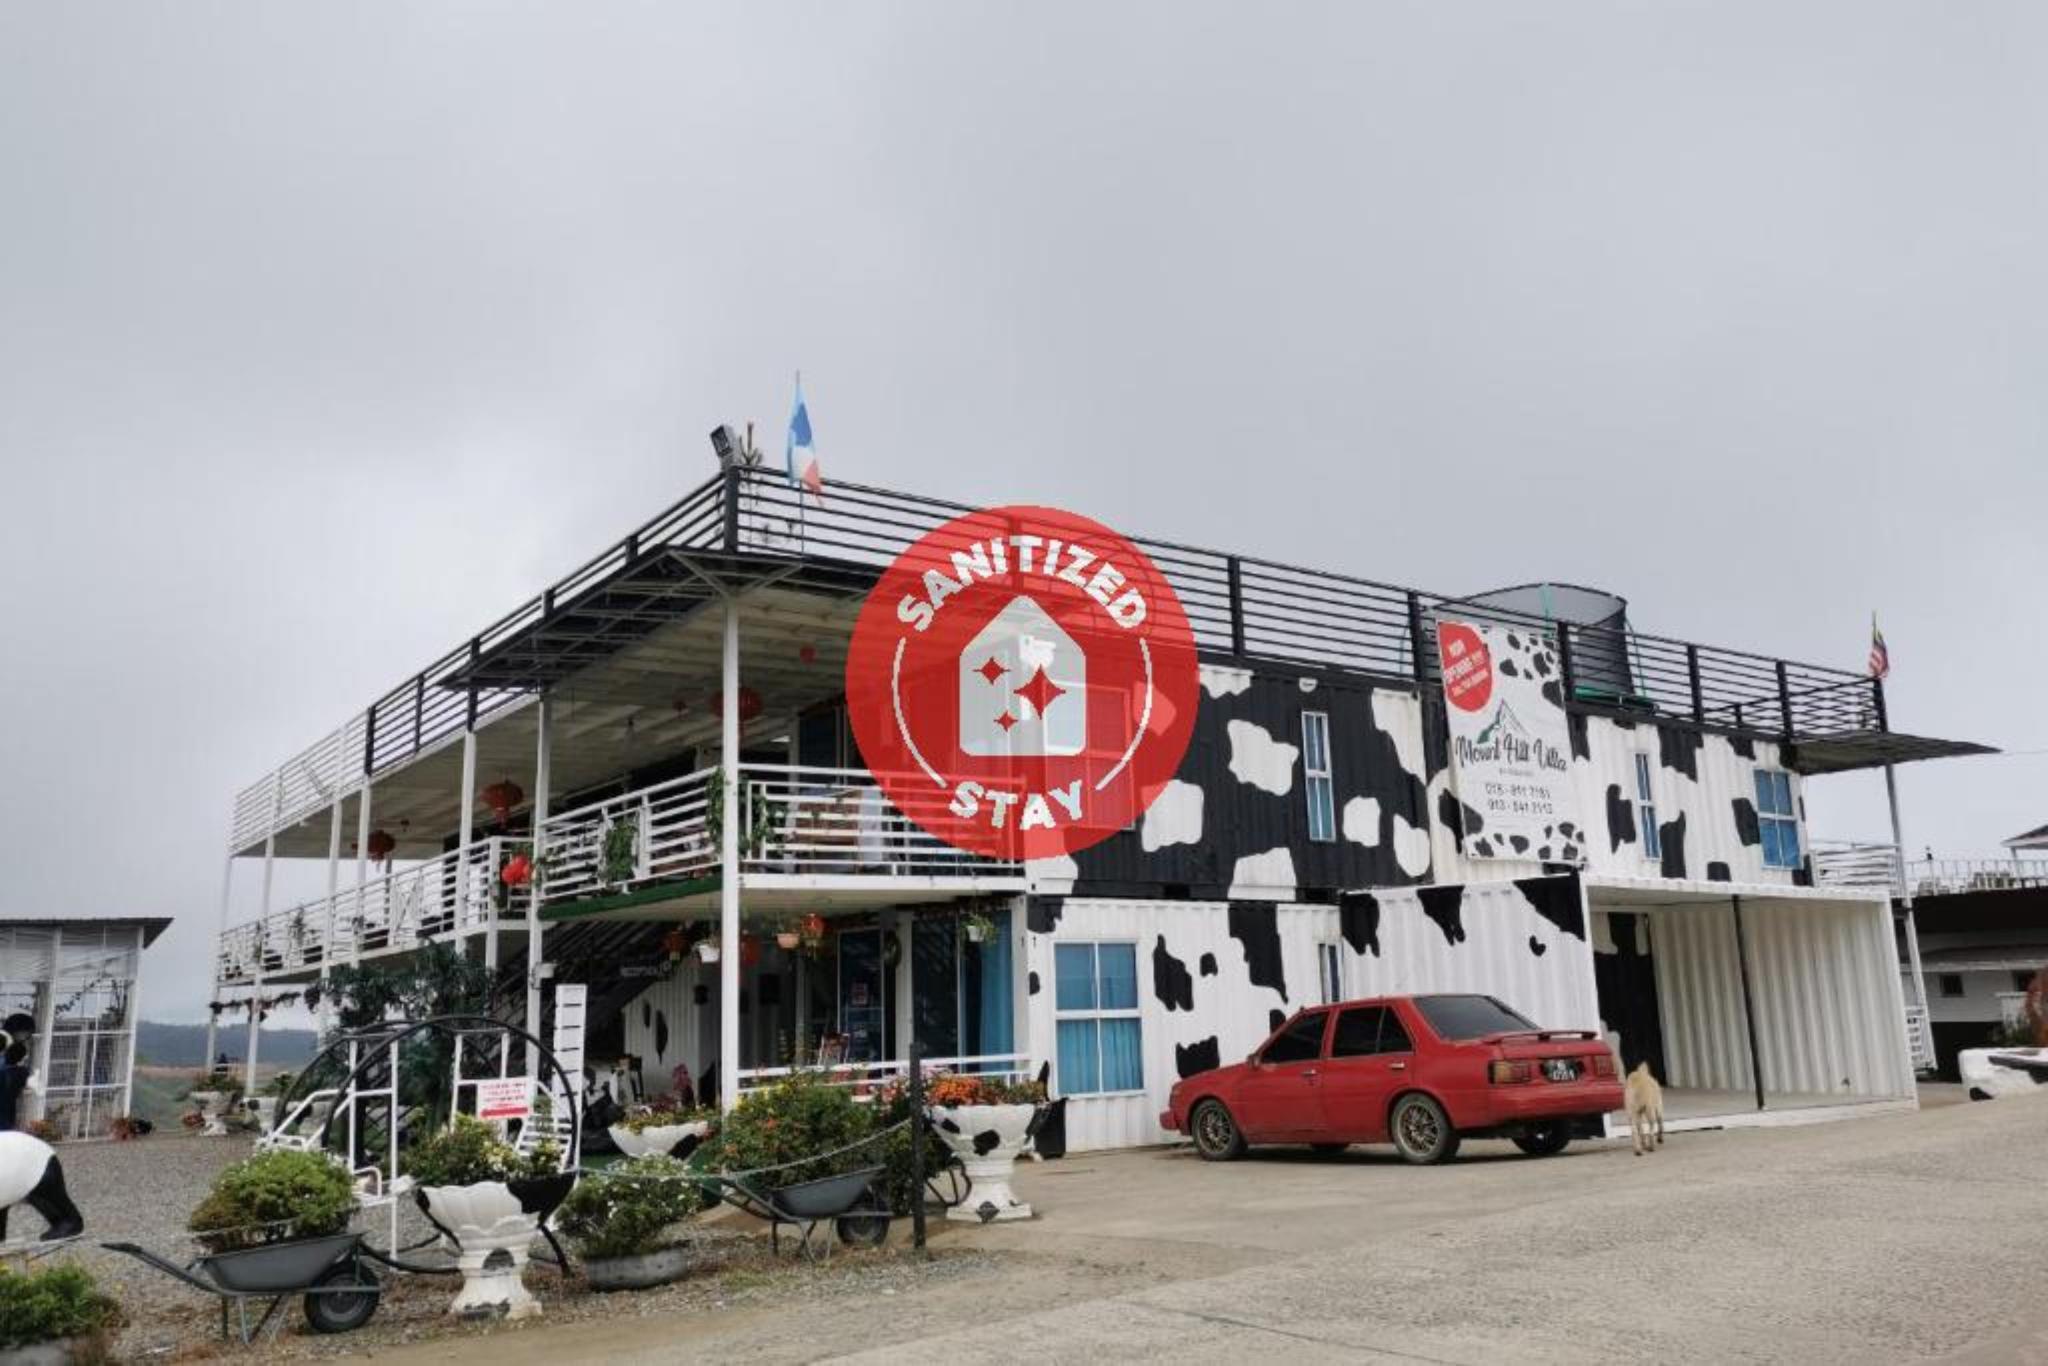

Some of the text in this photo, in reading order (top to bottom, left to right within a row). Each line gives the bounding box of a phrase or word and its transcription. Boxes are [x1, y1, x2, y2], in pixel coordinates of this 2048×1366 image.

[1456, 732, 1567, 772] Mount Hill Villa
